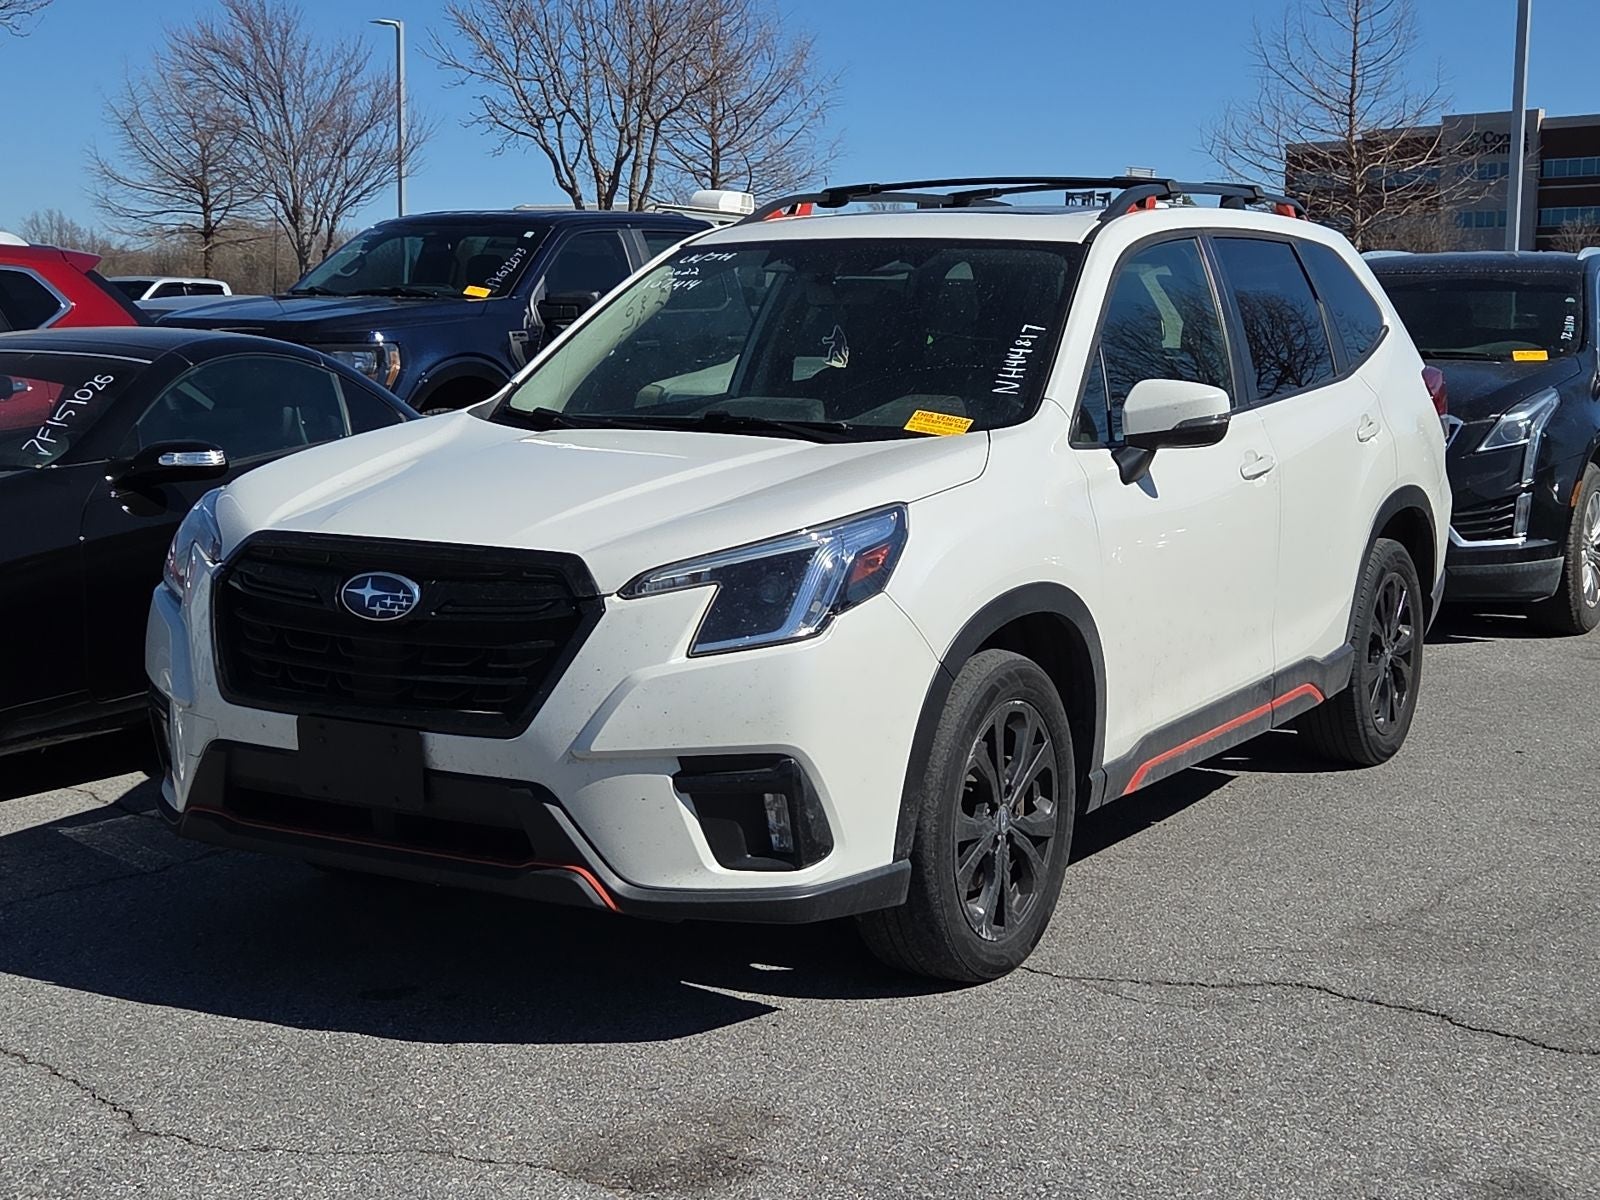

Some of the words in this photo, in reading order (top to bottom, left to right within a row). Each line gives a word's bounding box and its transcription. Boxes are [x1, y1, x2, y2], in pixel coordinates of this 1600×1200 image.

[21, 374, 114, 456] 7F151026
[916, 411, 934, 420] THIS
[937, 415, 972, 426] VEHICLE
